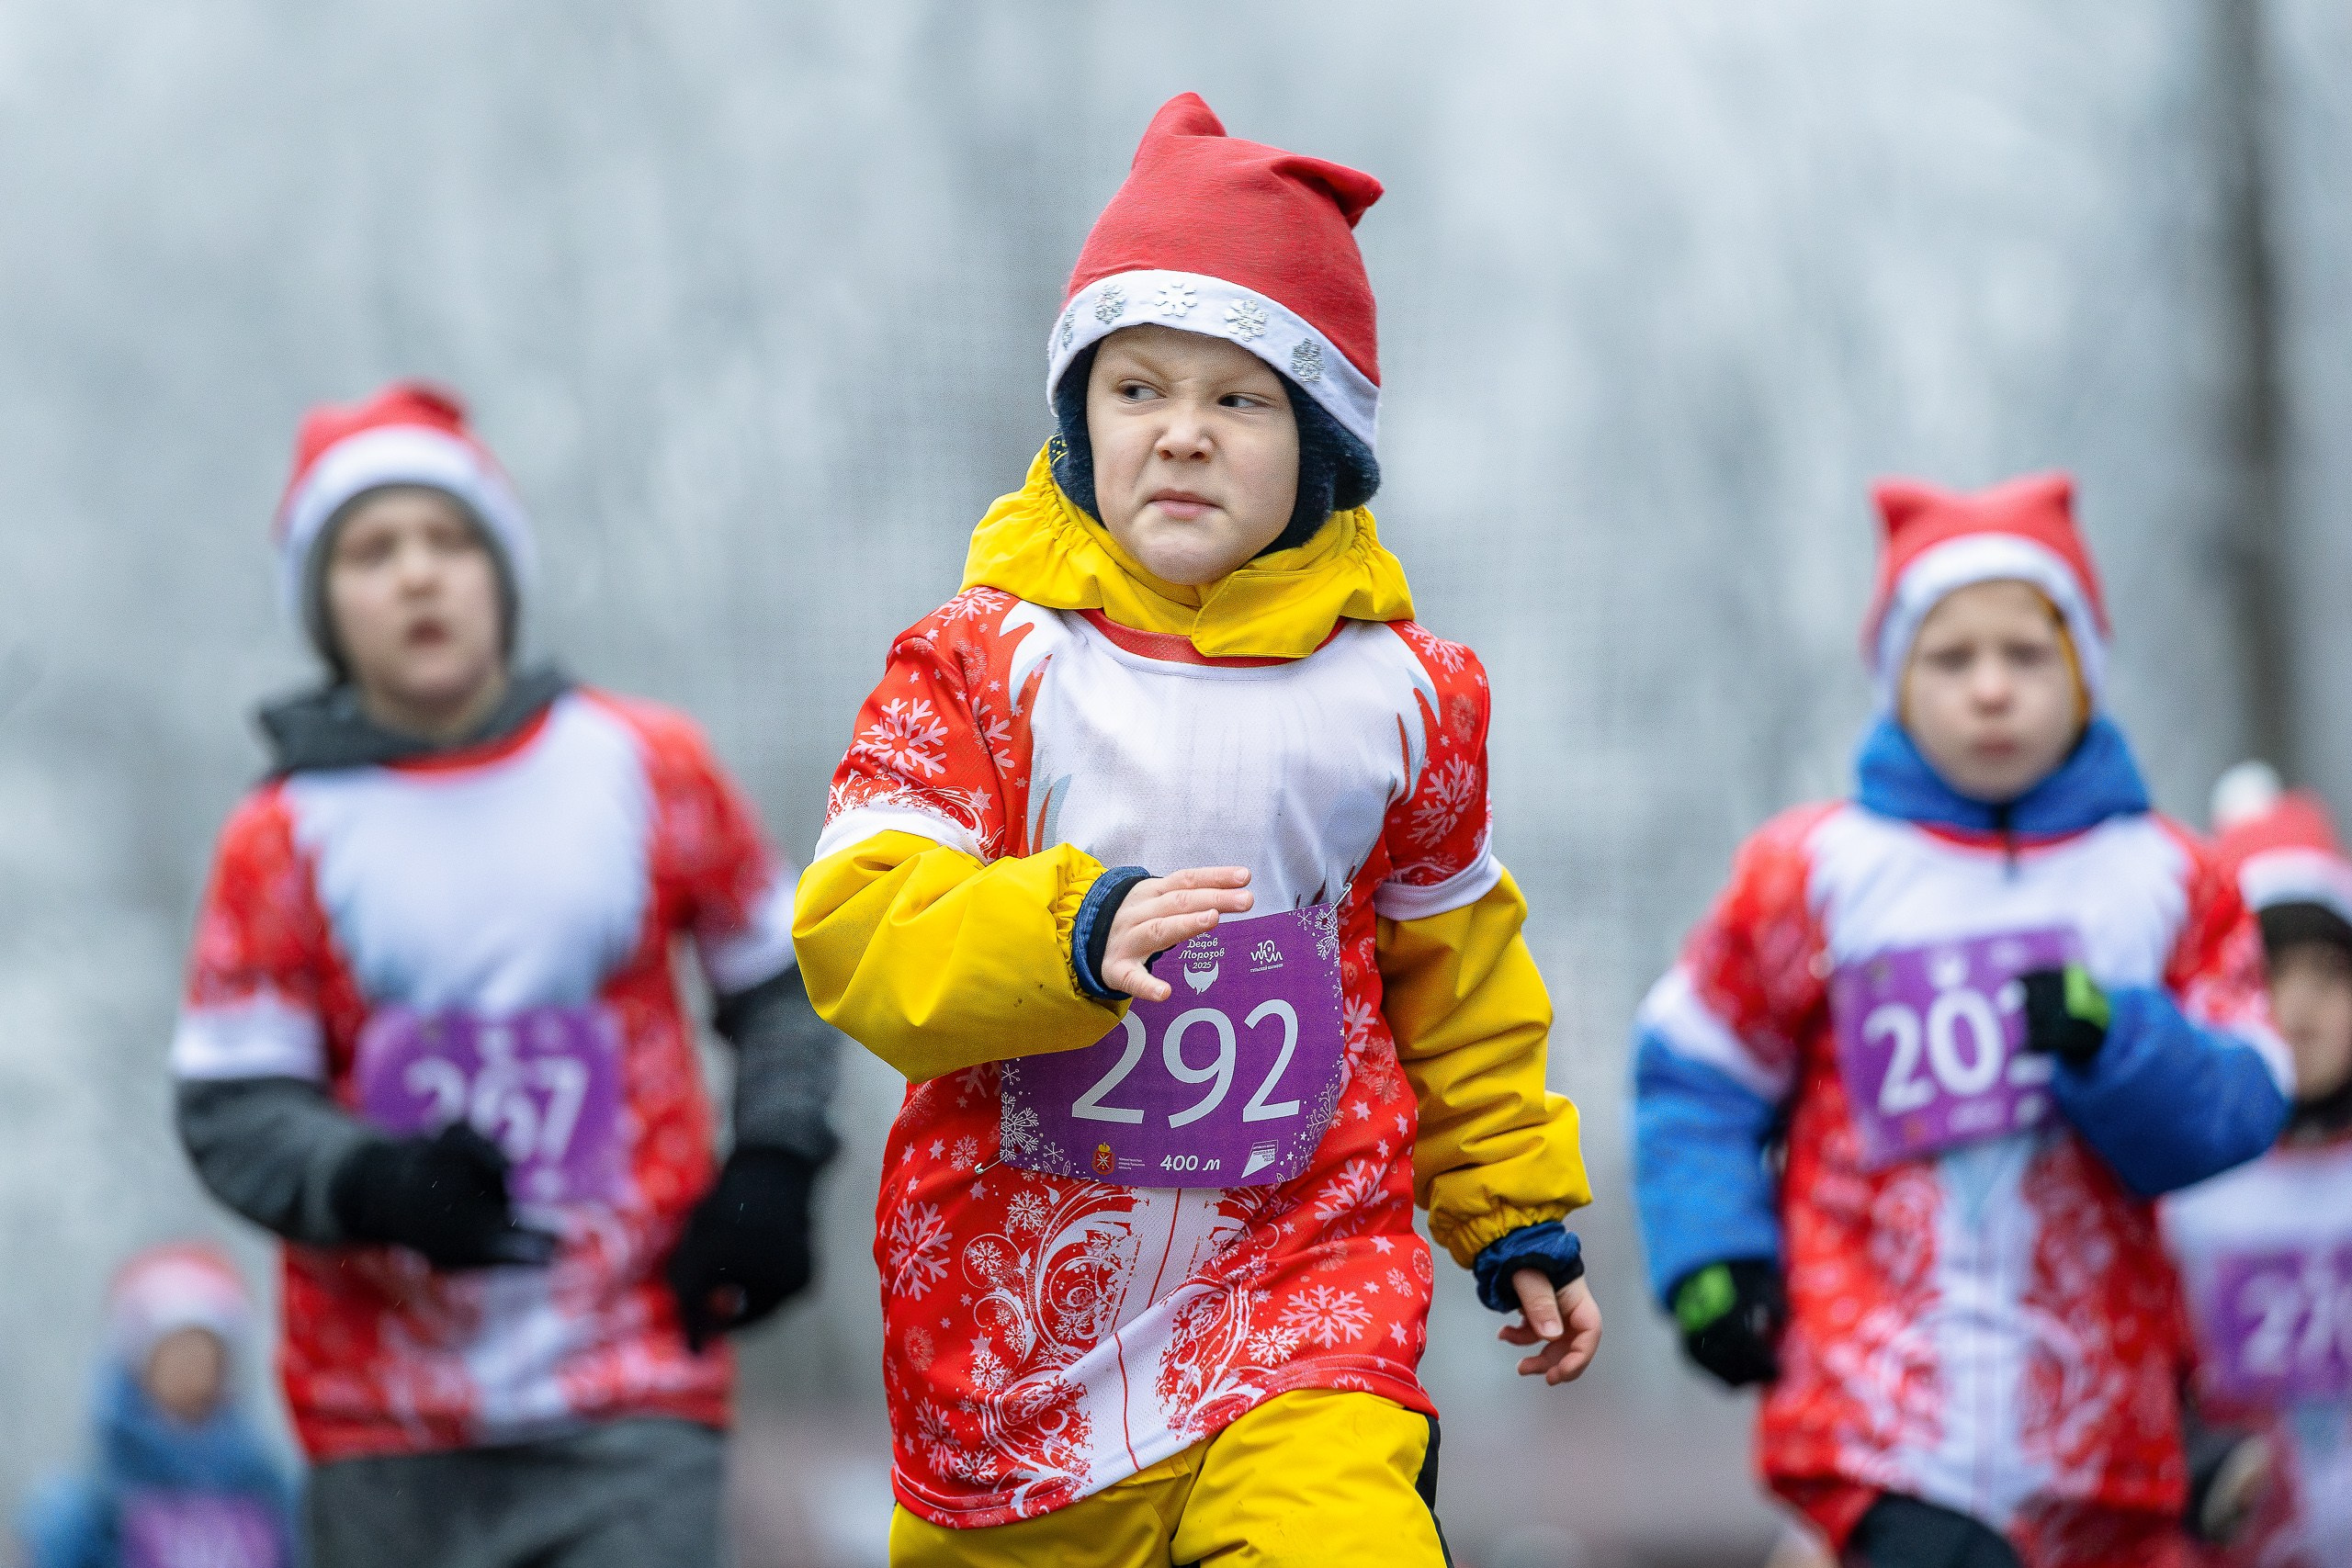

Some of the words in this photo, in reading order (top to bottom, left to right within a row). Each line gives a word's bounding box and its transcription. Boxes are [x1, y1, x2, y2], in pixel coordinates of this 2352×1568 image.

[1186, 937, 1218, 950] Дедов
[1178, 947, 1226, 962] Морозов
[1192, 961, 1213, 970] 2025
[1070, 998, 1301, 1130] 292
[1159, 1154, 1199, 1171] 400
